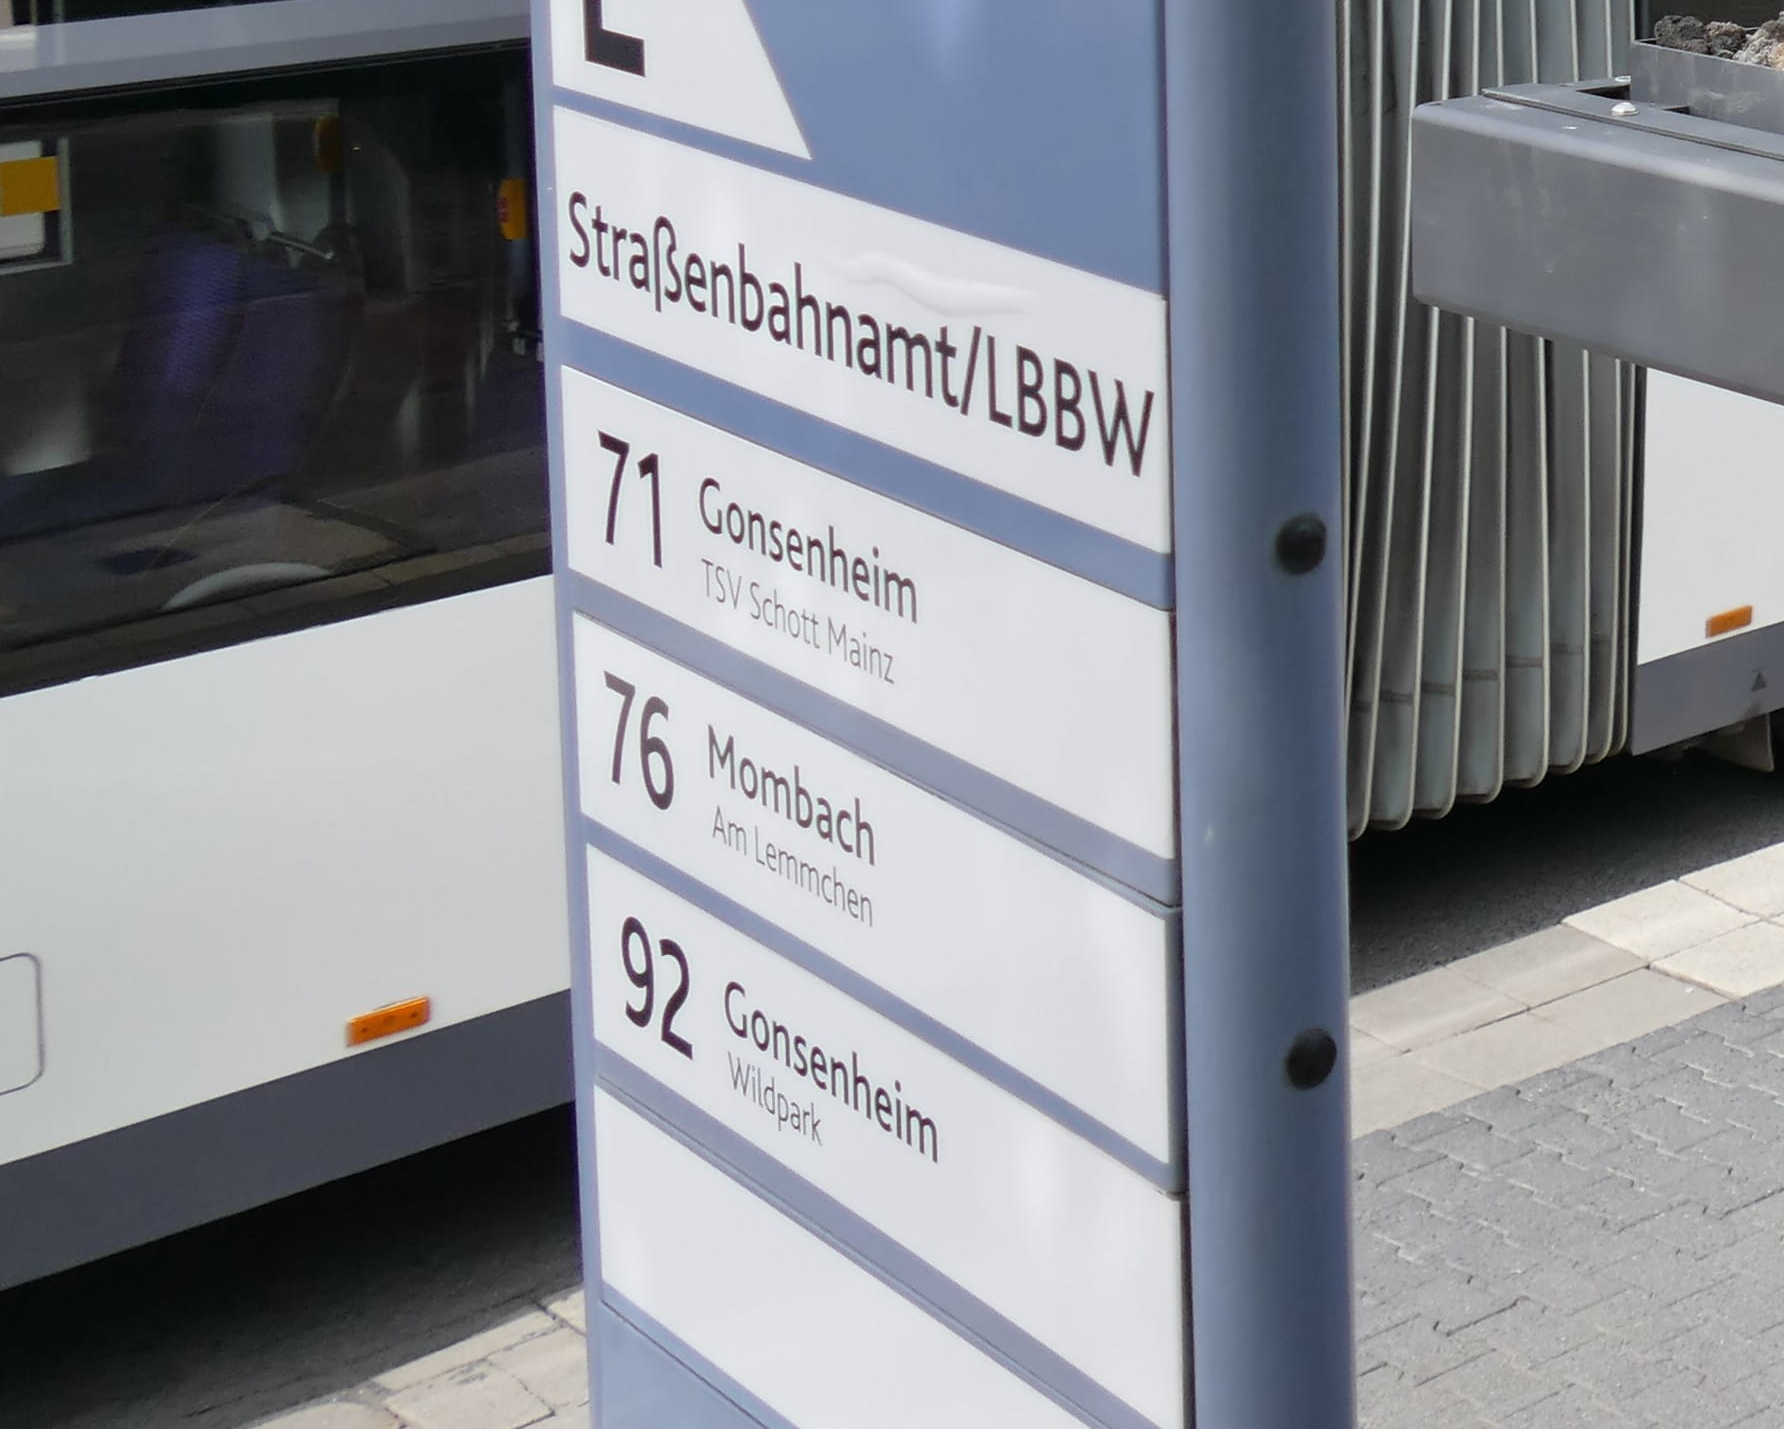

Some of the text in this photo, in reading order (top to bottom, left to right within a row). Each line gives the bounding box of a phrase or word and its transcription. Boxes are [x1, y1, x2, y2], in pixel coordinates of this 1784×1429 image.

[567, 190, 1154, 477] Straßenbahnamt/LBBW
[597, 429, 918, 624] 71 Gonsenheim
[701, 558, 895, 685] TSV Schott Mainz
[603, 670, 876, 866] 76 Mombach
[712, 805, 874, 928] Am Lemmchen
[621, 915, 939, 1164] 92 Gonsenheim
[727, 1050, 824, 1147] Wildpark
